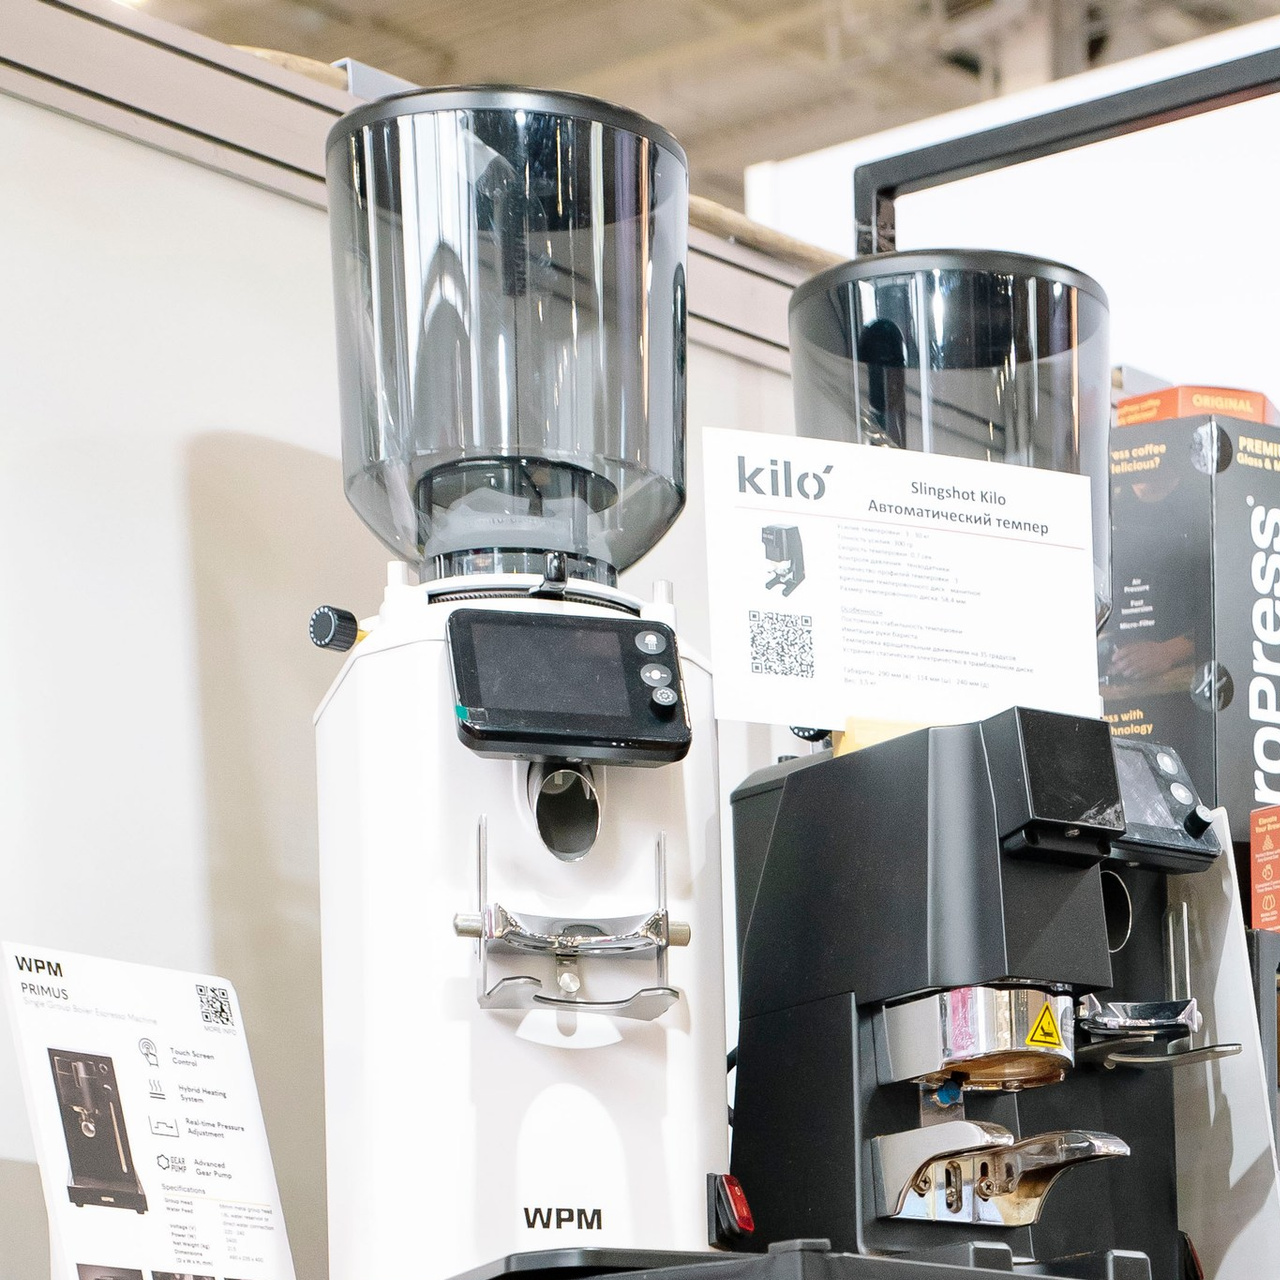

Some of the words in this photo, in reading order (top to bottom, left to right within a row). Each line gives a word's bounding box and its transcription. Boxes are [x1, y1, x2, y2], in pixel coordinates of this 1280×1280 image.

[1192, 394, 1253, 413] ORIGINAL
[1132, 445, 1167, 458] coffee
[1237, 453, 1263, 468] Glass
[911, 481, 976, 501] Slingshot
[981, 491, 1006, 506] Kilo
[868, 499, 991, 527] Автоматический
[996, 516, 1049, 537] темпер
[1121, 709, 1143, 721] with
[15, 955, 63, 977] WPM
[21, 982, 69, 1000] PRIMUS
[524, 1207, 602, 1230] WPM
